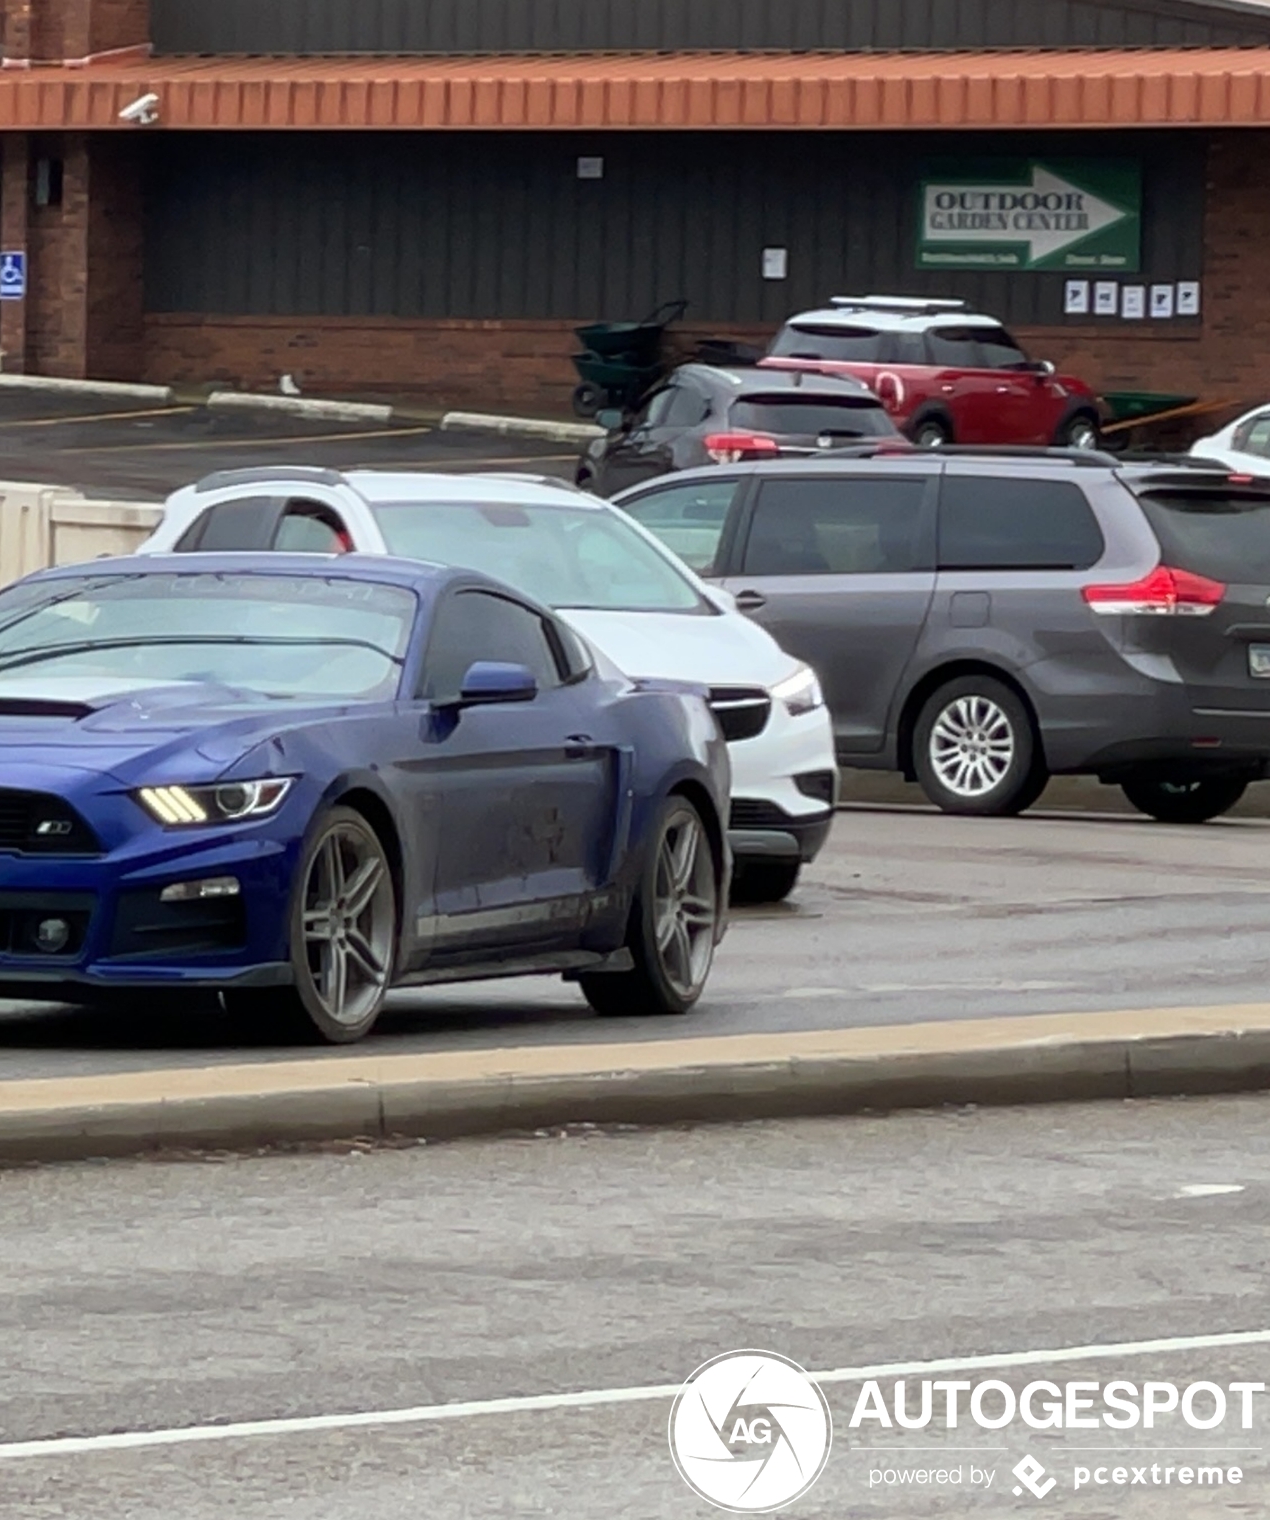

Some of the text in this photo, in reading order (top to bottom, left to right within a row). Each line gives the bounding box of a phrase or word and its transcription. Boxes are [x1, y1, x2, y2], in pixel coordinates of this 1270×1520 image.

[935, 192, 1084, 211] OUTDOOR
[931, 212, 1089, 231] GARDEN CENTER
